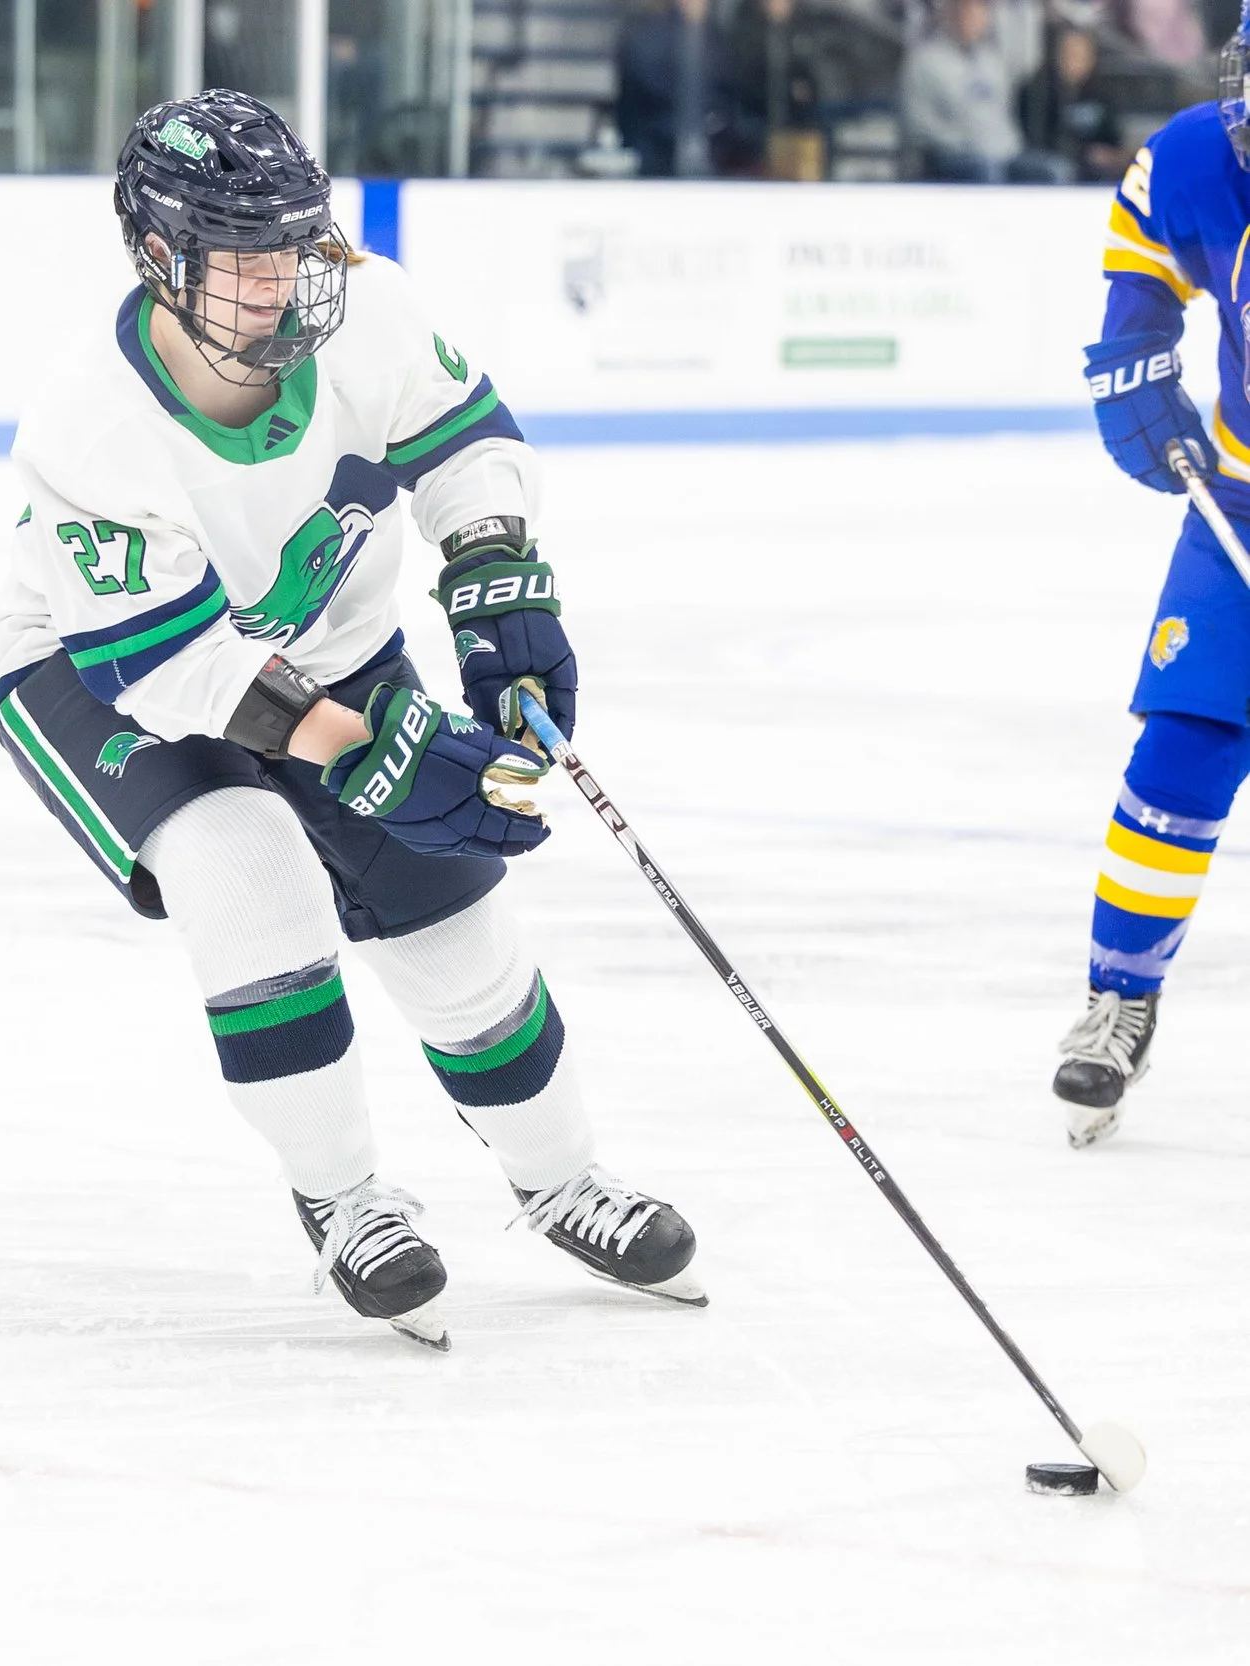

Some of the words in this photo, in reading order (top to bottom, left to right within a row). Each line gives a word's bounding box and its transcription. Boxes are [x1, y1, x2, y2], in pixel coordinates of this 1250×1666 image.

[158, 119, 211, 160] GULLS
[140, 185, 183, 211] BAUER
[280, 204, 324, 224] BAUER
[1089, 350, 1181, 400] AUE
[57, 520, 152, 595] 27
[449, 574, 561, 615] BAU
[348, 689, 434, 817] BAUER
[662, 889, 680, 910] FLEX
[730, 983, 772, 1030] BAUER
